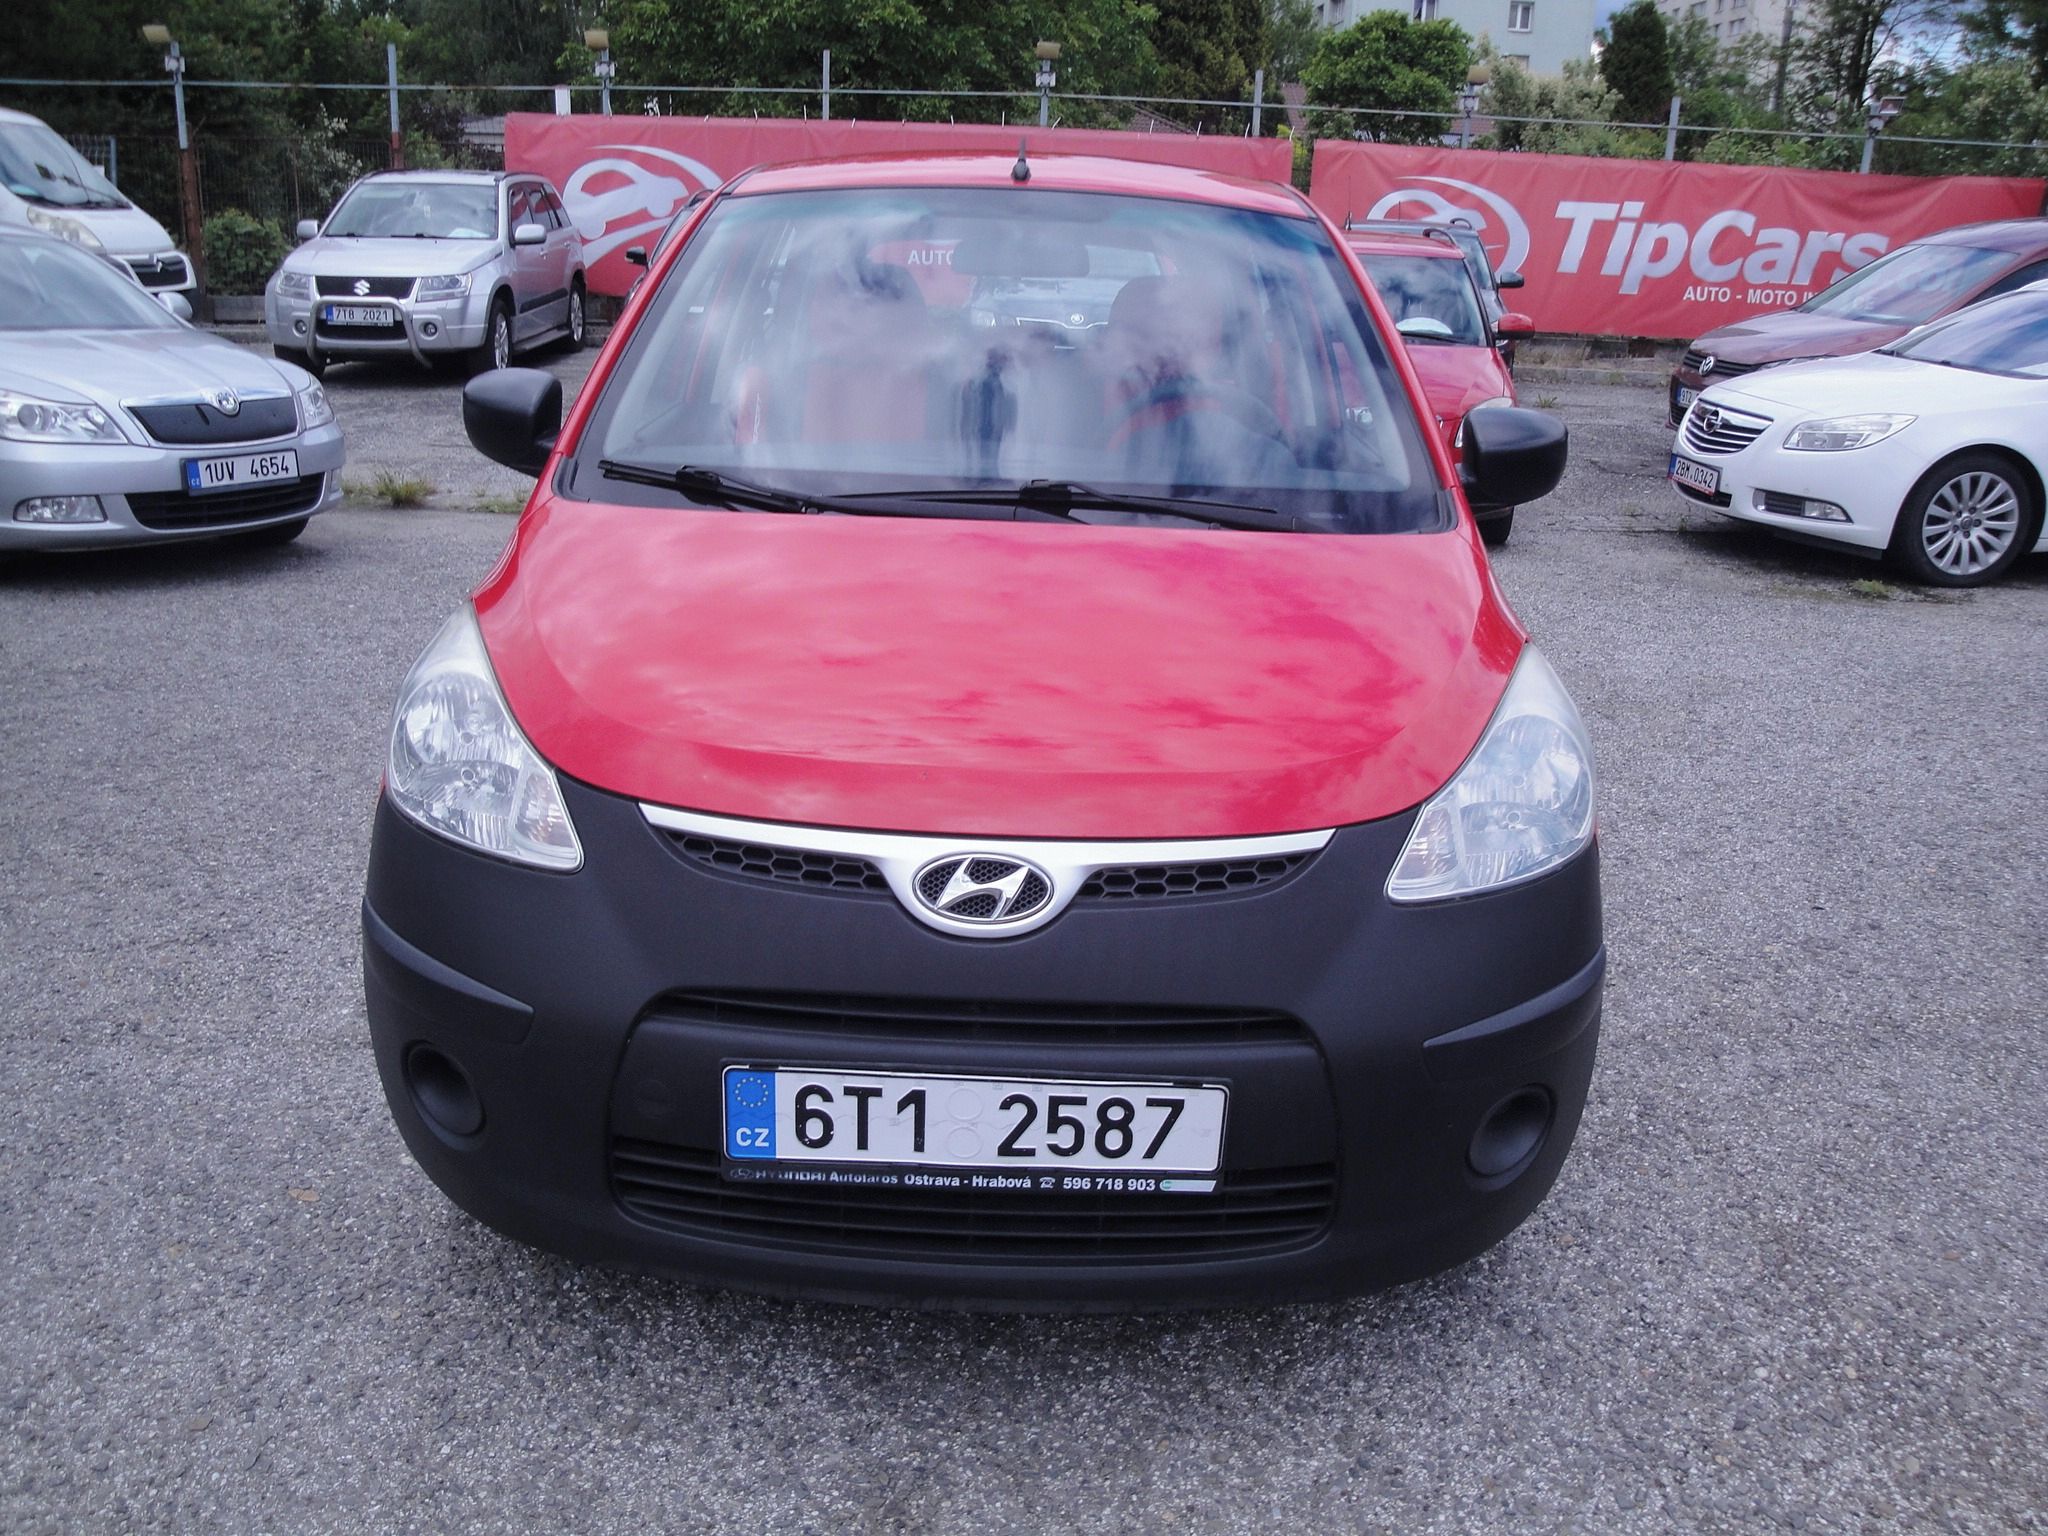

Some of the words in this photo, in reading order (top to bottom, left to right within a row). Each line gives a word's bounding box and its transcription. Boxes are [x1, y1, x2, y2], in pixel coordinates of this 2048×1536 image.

[1555, 200, 1889, 295] TipCars
[1683, 286, 1730, 303] AUTO
[1747, 289, 1797, 306] MOTO
[336, 308, 355, 320] 7T8
[362, 308, 388, 321] 2021
[205, 461, 235, 483] 1UV
[250, 455, 289, 478] 4654
[1693, 466, 1714, 489] 0342
[795, 1084, 926, 1153] 6T1
[997, 1093, 1185, 1159] 2587
[735, 1127, 770, 1148] CZ
[904, 1173, 960, 1187] Ostrava
[971, 1175, 1031, 1188] Hrabová
[1063, 1177, 1091, 1189] 596
[1095, 1178, 1123, 1190] 718
[1127, 1178, 1155, 1191] 903
